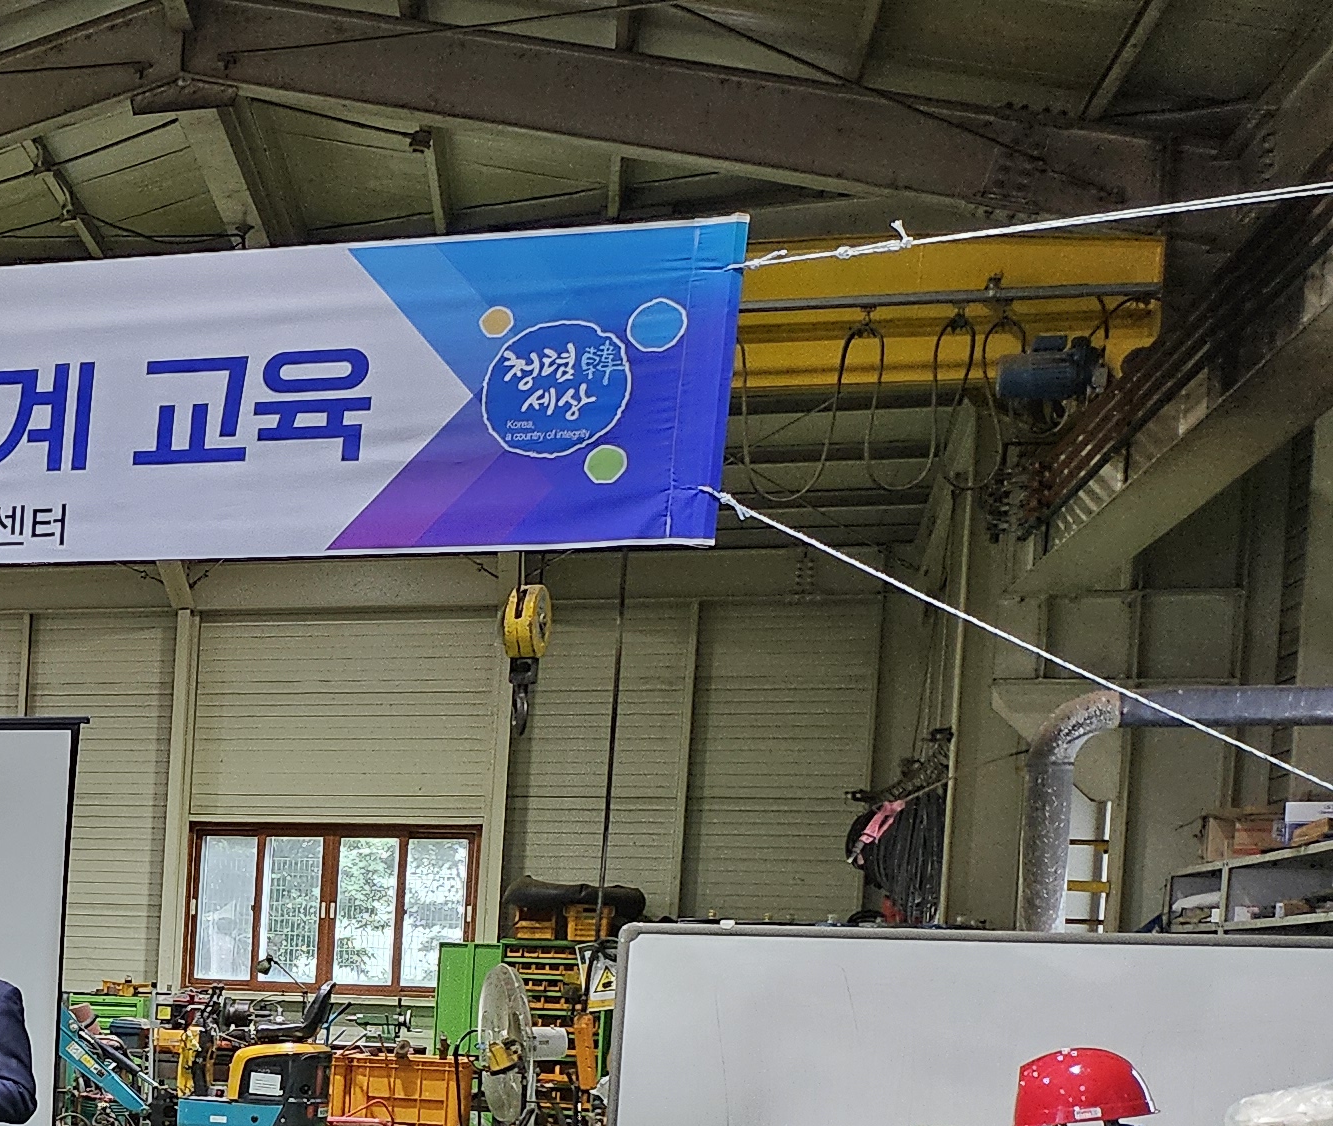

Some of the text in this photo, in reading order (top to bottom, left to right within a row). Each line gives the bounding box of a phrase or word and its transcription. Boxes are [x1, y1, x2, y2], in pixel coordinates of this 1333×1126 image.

[133, 348, 373, 466] 교육
[520, 383, 597, 421] 세상
[505, 428, 590, 442] a country of integrity
[506, 419, 535, 430] Korea,
